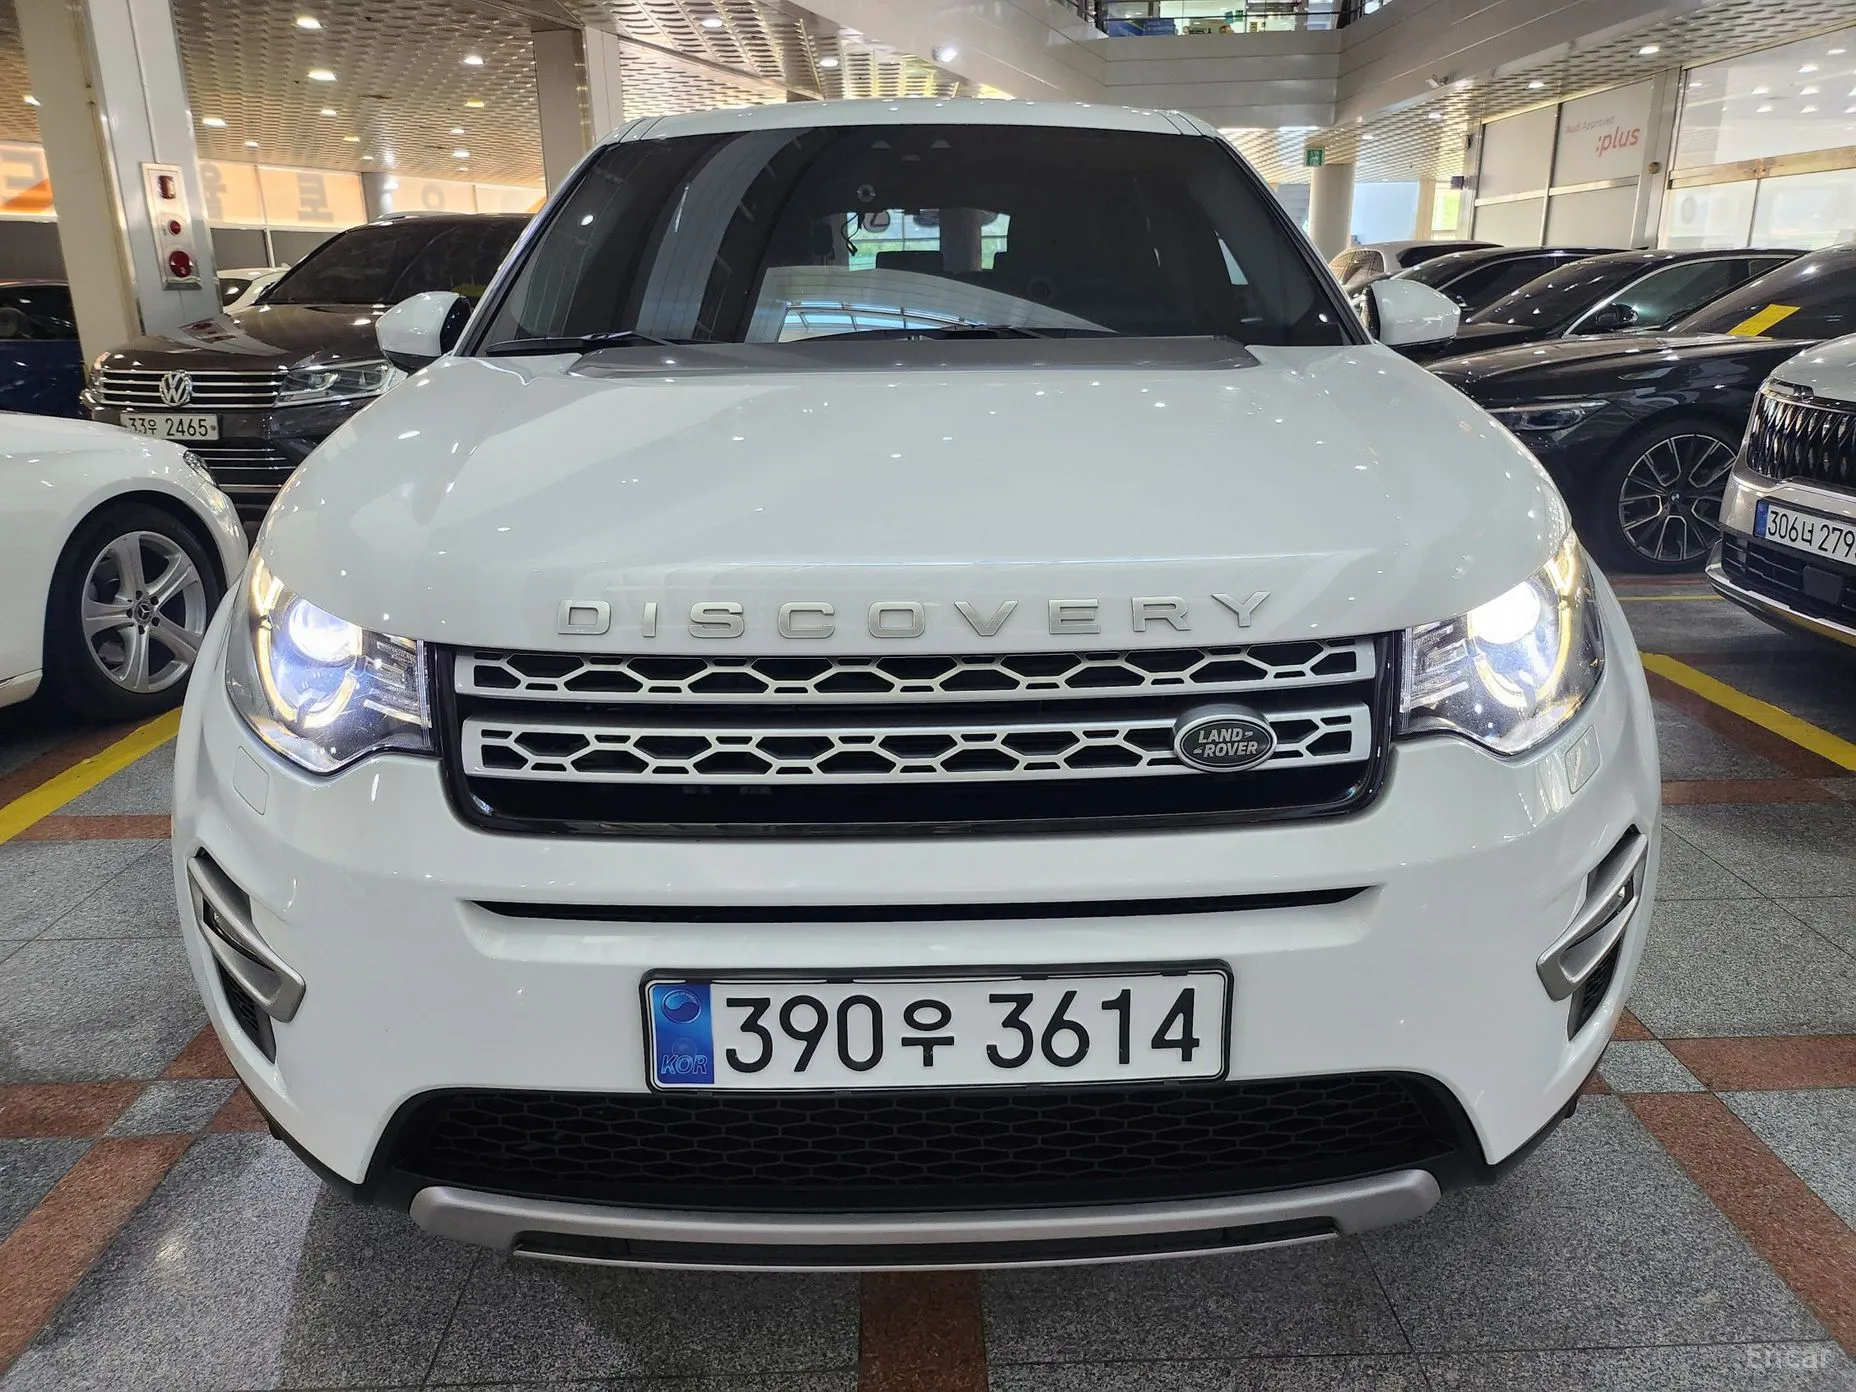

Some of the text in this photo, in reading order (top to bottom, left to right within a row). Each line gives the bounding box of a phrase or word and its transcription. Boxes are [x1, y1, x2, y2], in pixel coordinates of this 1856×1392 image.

[1583, 116, 1615, 131] Approved
[165, 417, 208, 437] 2465
[1768, 510, 1856, 559] 306너 279
[557, 591, 1271, 639] DISCOVERY
[1198, 728, 1243, 743] LAND
[1203, 741, 1258, 758] ROVER
[725, 987, 1201, 1073] 390우 3614
[660, 1054, 709, 1075] KOR
